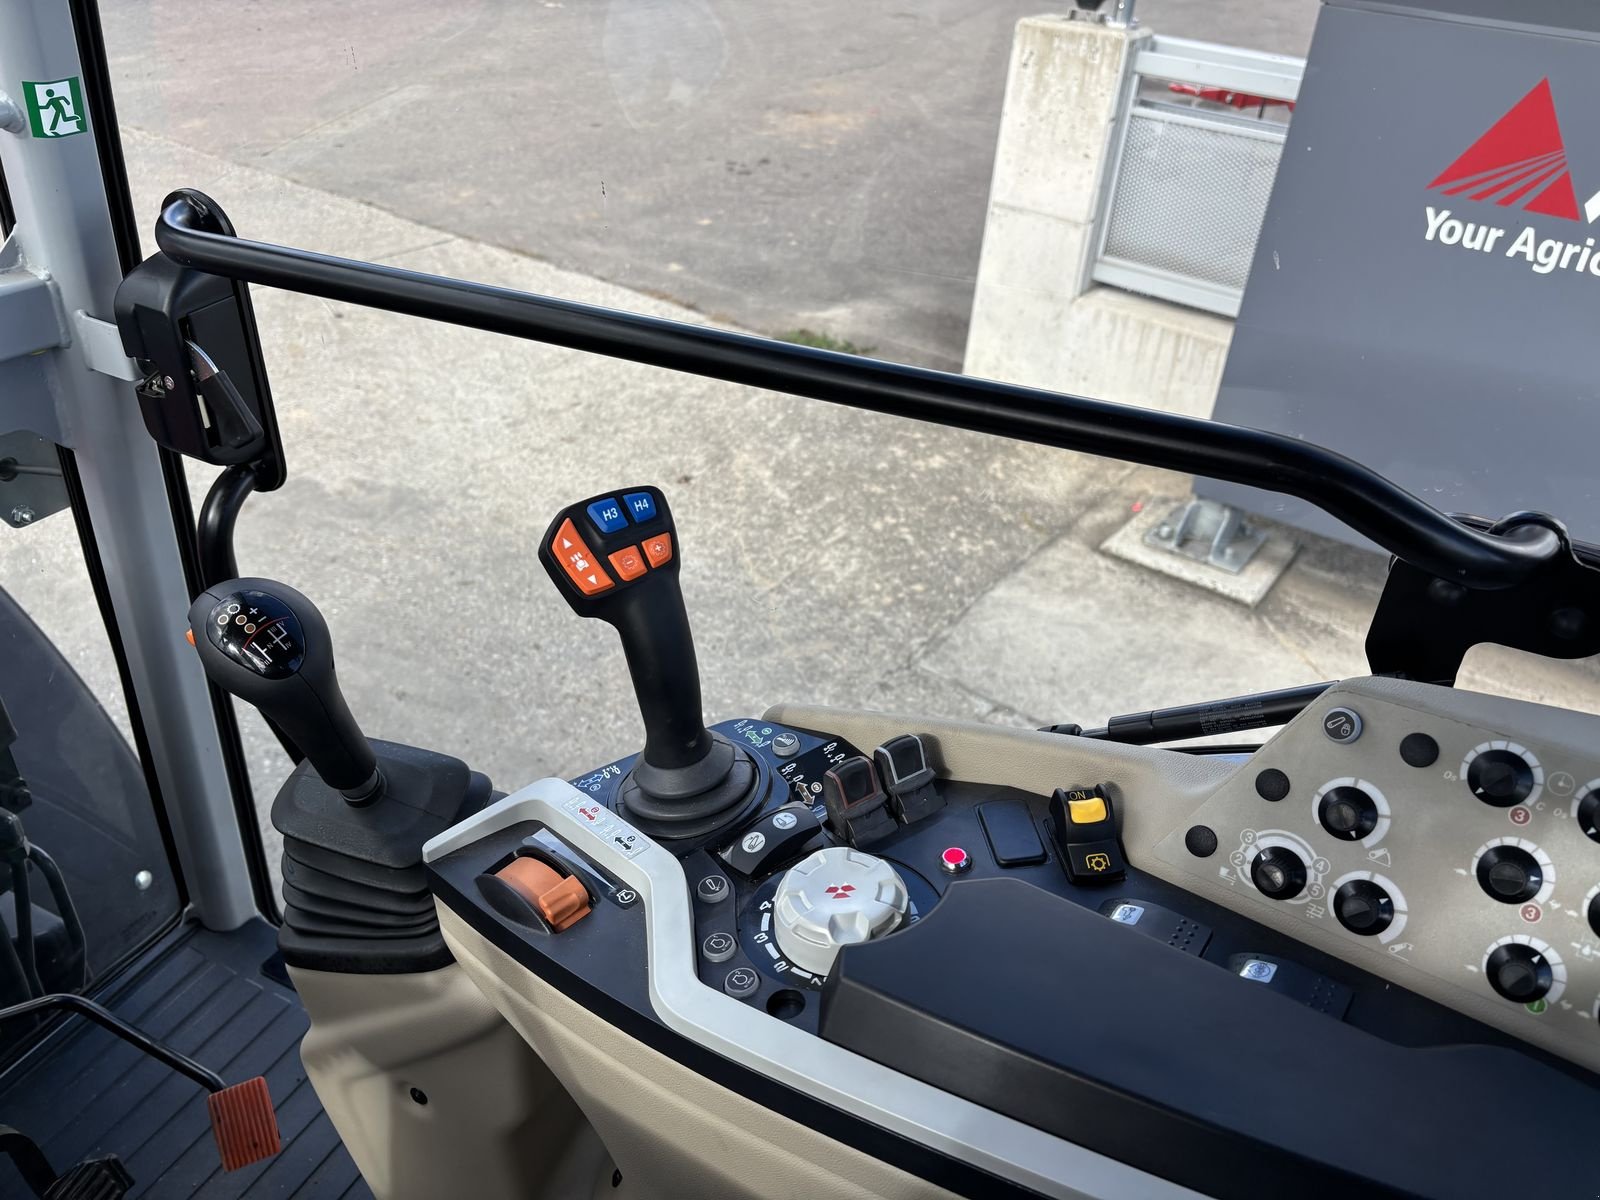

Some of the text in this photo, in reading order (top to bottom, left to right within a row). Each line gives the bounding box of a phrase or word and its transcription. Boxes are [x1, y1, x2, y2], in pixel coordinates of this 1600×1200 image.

[1425, 206, 1505, 253] Your
[633, 498, 649, 512] H4
[602, 507, 618, 521] H3
[1069, 791, 1086, 800] ON
[759, 901, 772, 910] 4
[753, 933, 768, 943] 3
[773, 961, 789, 973] 2
